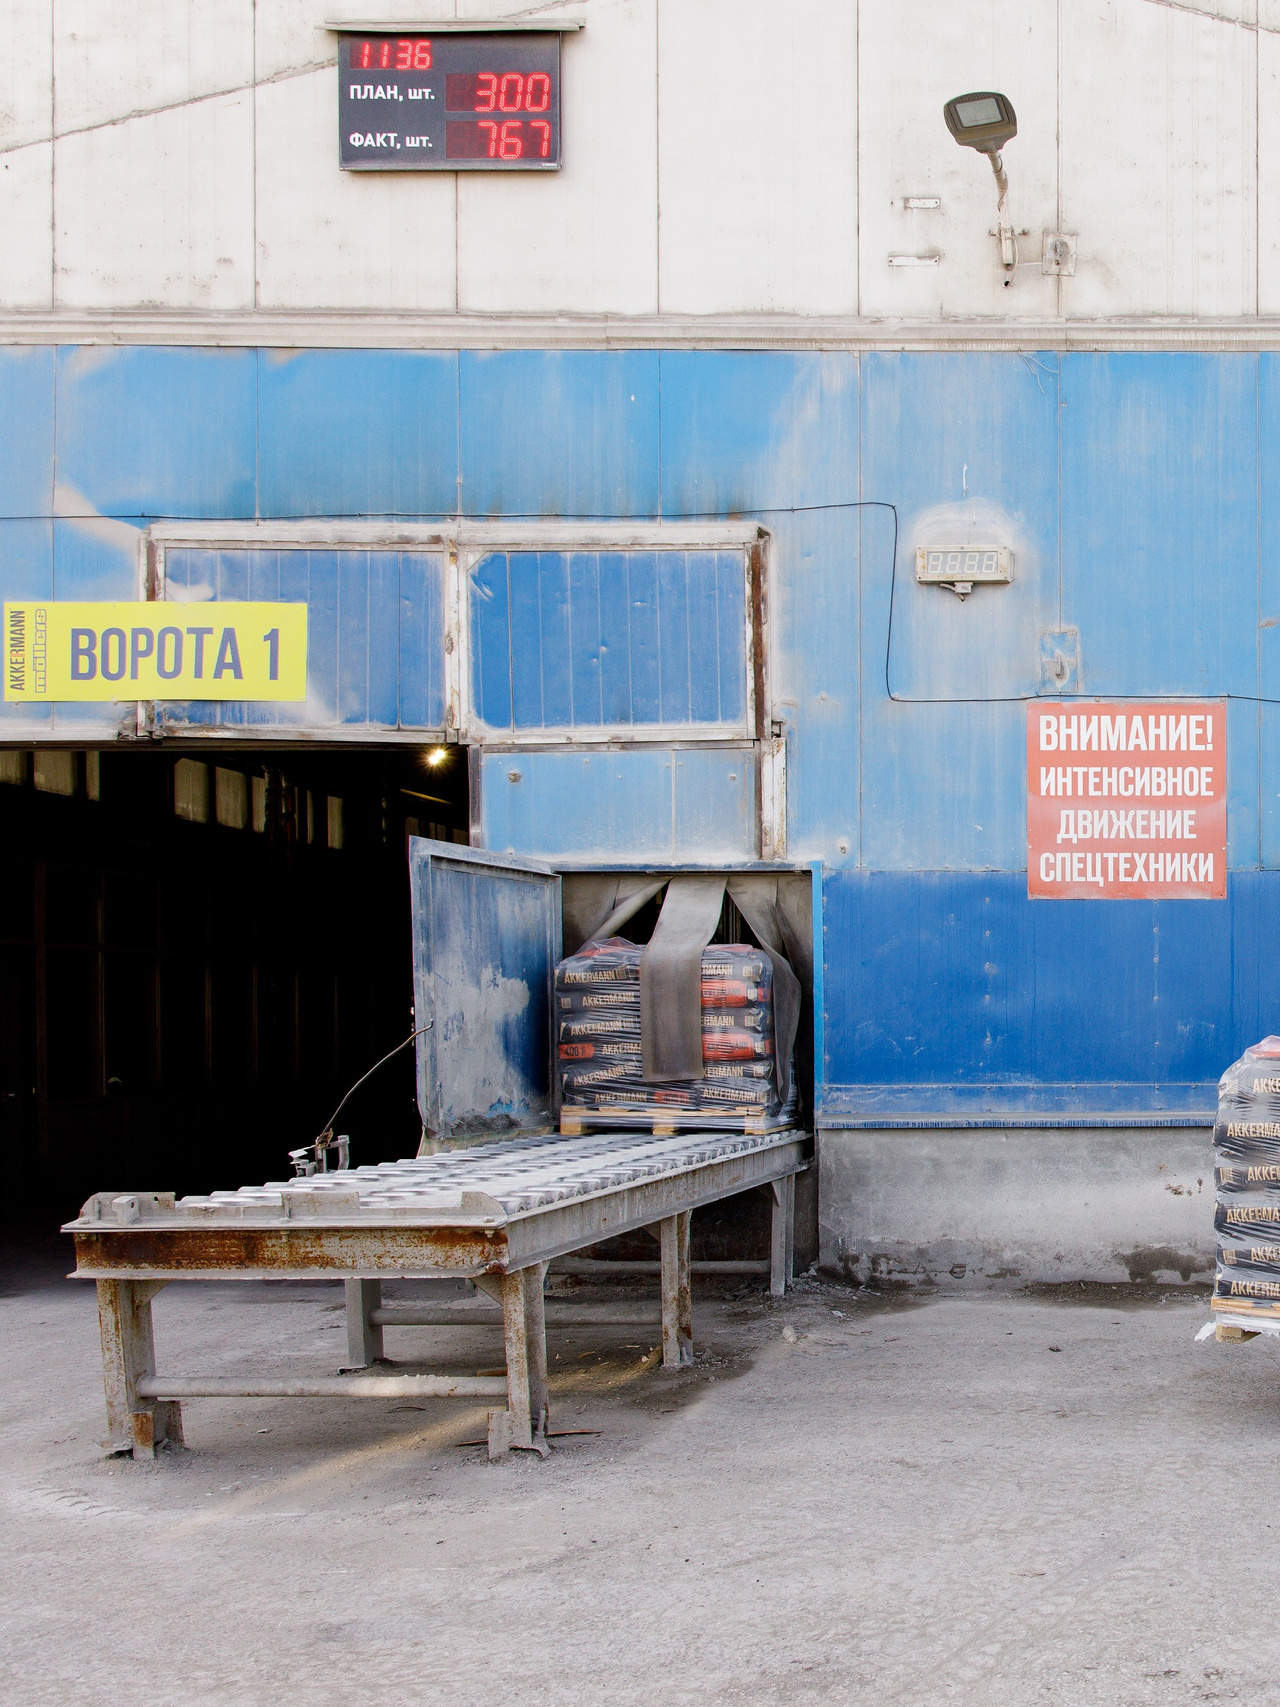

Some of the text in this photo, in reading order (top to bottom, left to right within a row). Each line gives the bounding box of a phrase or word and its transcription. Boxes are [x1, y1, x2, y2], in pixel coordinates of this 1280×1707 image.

[361, 40, 431, 70] 1136
[349, 85, 436, 102] ПЛАН, шт.
[475, 73, 550, 112] 300
[349, 132, 433, 150] ФАКТ, шт.
[478, 121, 550, 160] 767
[9, 610, 25, 691] AKKERMANN
[70, 626, 280, 681] ВОРОТА 1
[1039, 715, 1213, 751] ВНИМАНИЕ!
[1040, 766, 1214, 797] ИНТЕНСИВНОЕ
[1056, 809, 1197, 844] ДВИЖЕНИЕ
[1039, 852, 1214, 887] СПЕЦТЕХНИКИ
